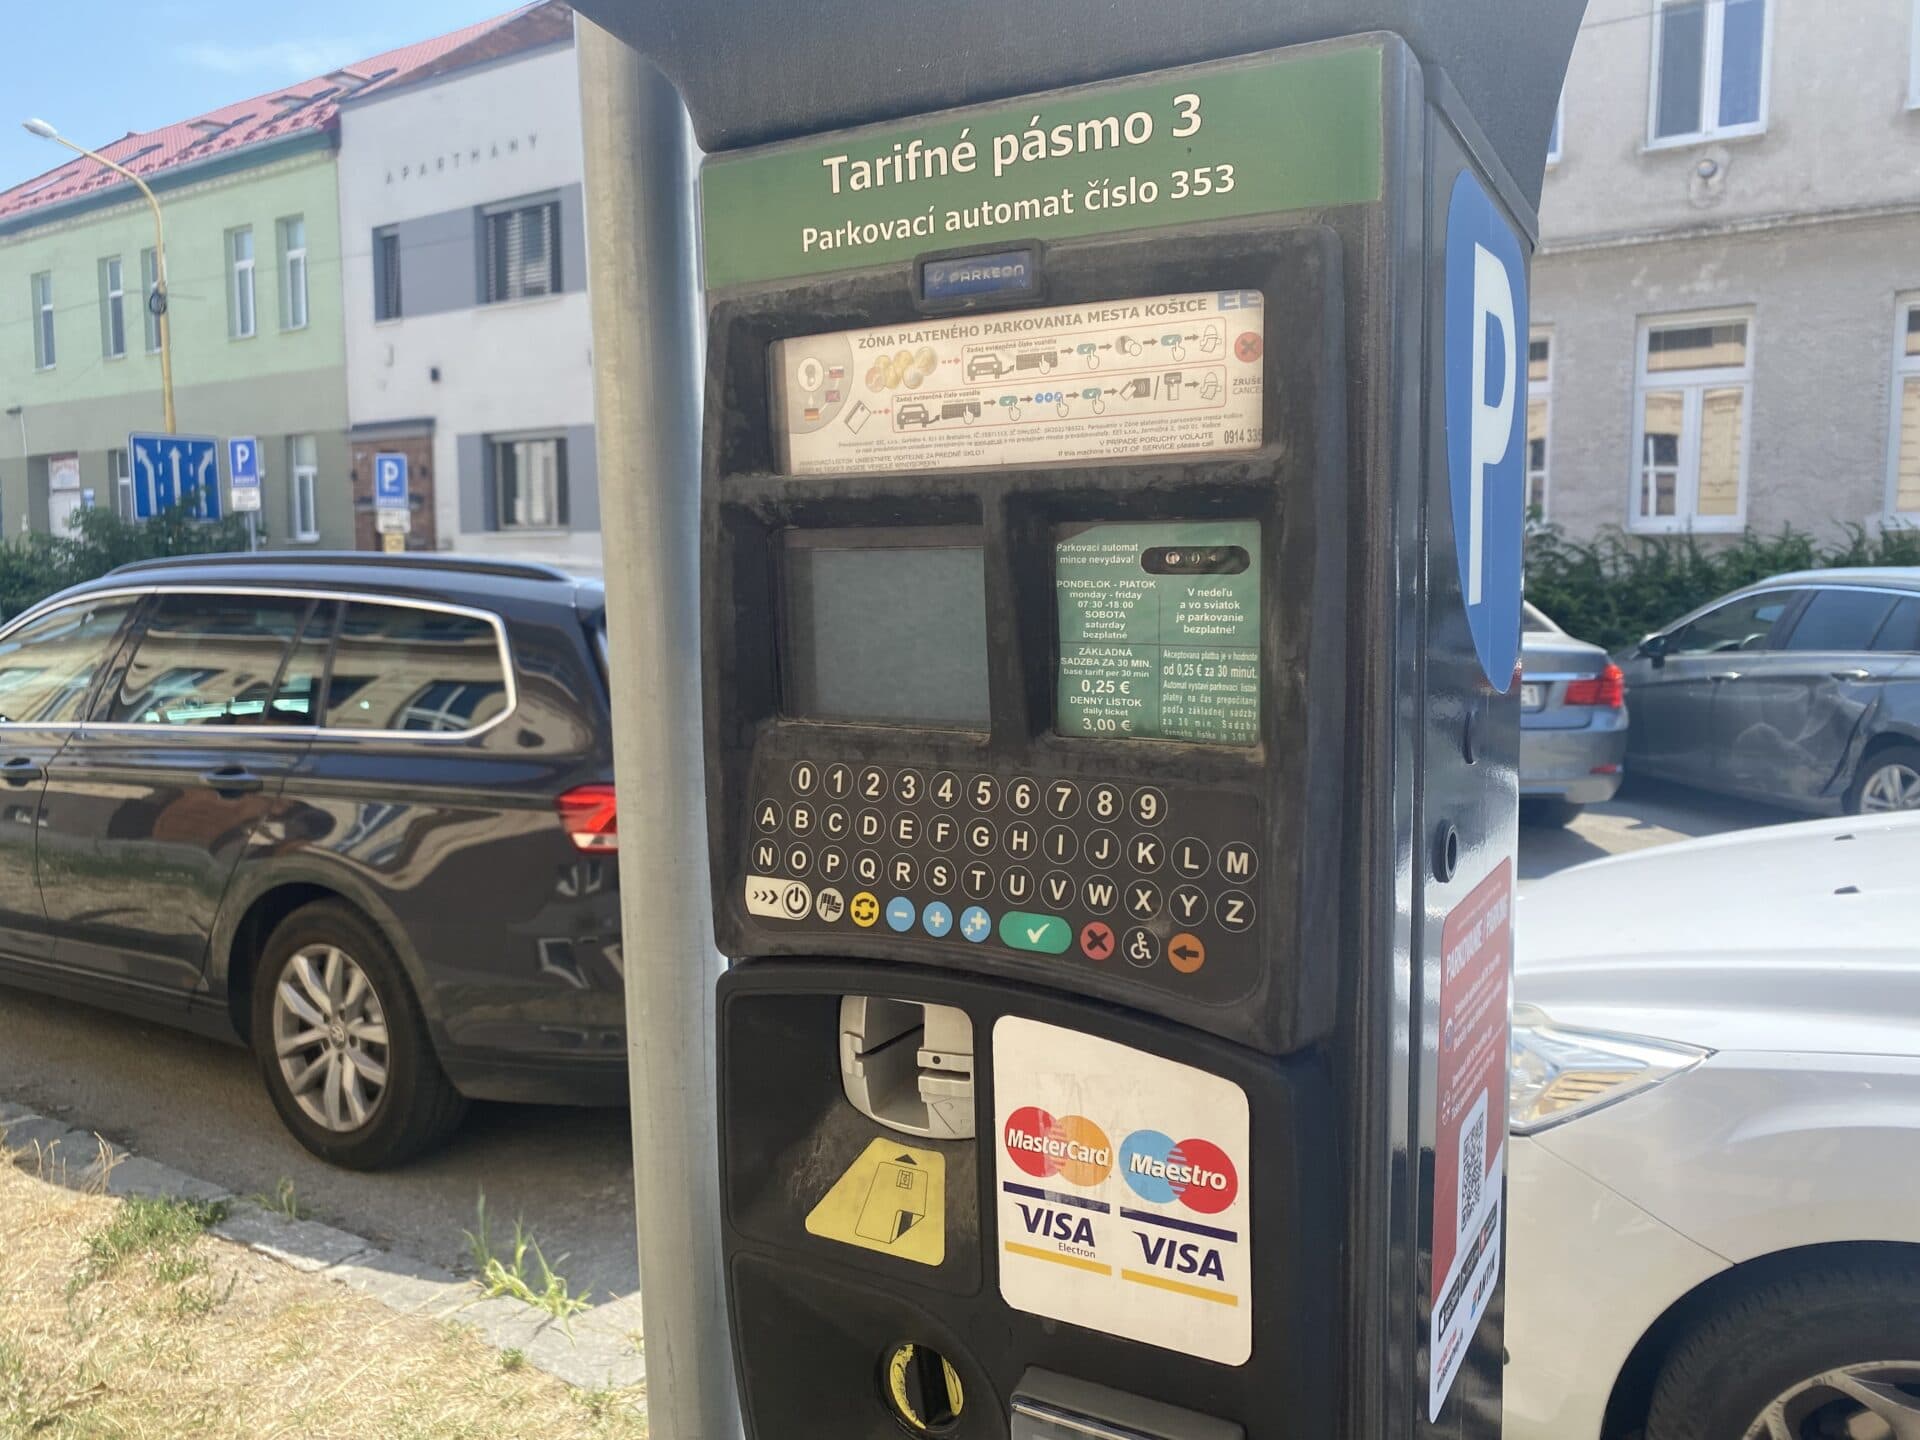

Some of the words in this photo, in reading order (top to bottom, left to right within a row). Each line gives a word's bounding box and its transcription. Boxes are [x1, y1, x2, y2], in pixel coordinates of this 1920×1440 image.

[823, 127, 977, 195] Tarifné
[993, 110, 1154, 176] pásmo
[1172, 93, 1202, 137] 3
[802, 205, 935, 253] Parkovací
[945, 187, 1074, 231] automat
[1084, 174, 1159, 211] číslo
[1170, 164, 1236, 200] 353
[858, 333, 895, 349] ZÓNA
[899, 321, 980, 345] PLATENÉHO
[984, 314, 1083, 334] PARKOVANIA
[1087, 306, 1141, 324] MESTA
[1145, 298, 1208, 317] KOŠICE
[1469, 242, 1517, 606] P
[1224, 428, 1245, 444] 0914
[237, 443, 250, 473] P
[384, 460, 399, 493] P
[1102, 543, 1138, 552] automat
[1060, 555, 1087, 564] mince
[1056, 580, 1111, 588] PONDELOK
[1119, 580, 1156, 588] PIATOK
[1069, 590, 1107, 600] monday
[1115, 590, 1142, 600] friday
[1187, 588, 1195, 597] V
[1203, 600, 1240, 609] sviatok
[1085, 610, 1126, 619] SOBOTA
[1176, 612, 1185, 623] je
[1188, 612, 1244, 623] parkovanie
[1085, 620, 1126, 631] saturday
[1060, 657, 1100, 666] SADZBA
[1102, 658, 1115, 667] ZA
[1117, 659, 1129, 667] 30
[1105, 670, 1120, 678] per
[1121, 669, 1132, 677] 30
[1163, 663, 1175, 676] od
[1196, 663, 1203, 677] €
[1205, 667, 1215, 677] za
[1217, 665, 1228, 678] 30
[1081, 679, 1115, 695] 0,25
[1120, 681, 1131, 694] €
[1070, 695, 1104, 705] DENNÝ
[1083, 707, 1103, 717] daily
[1105, 707, 1129, 716] ticket
[1082, 717, 1116, 732] 3,00
[1121, 720, 1132, 732] €
[798, 767, 811, 790] 0
[833, 769, 843, 793] 1
[865, 772, 880, 796] 2
[901, 775, 916, 799] 3
[937, 778, 953, 803] 4
[976, 780, 991, 806] 5
[1015, 784, 1030, 809] 6
[1056, 787, 1072, 812] 7
[1097, 790, 1113, 816] 8
[1140, 793, 1157, 820] 9
[761, 806, 776, 826] A
[794, 809, 809, 829] B
[828, 812, 843, 833] C
[863, 815, 878, 836] D
[899, 819, 914, 840] E
[936, 822, 950, 843] F
[972, 826, 990, 847] G
[1012, 829, 1028, 852] H
[1057, 834, 1064, 856] I
[1095, 838, 1109, 860] J
[1137, 841, 1156, 865] K
[1183, 846, 1199, 870] L
[1226, 850, 1249, 875] M
[759, 846, 773, 866] N
[791, 850, 807, 870] O
[826, 853, 840, 873] P
[859, 857, 876, 880] Q
[896, 861, 911, 883] R
[932, 865, 947, 887] S
[971, 869, 986, 891] T
[1009, 874, 1026, 896] U
[1050, 878, 1067, 901] V
[1088, 883, 1113, 907] W
[1134, 888, 1152, 912] X
[1179, 893, 1198, 917] Y
[1225, 899, 1244, 924] Z
[1007, 1128, 1110, 1168] MasterCard
[1129, 1152, 1228, 1190] Maestro
[1015, 1202, 1096, 1248] VISA
[1058, 1242, 1096, 1259] Electron
[1132, 1230, 1225, 1282] VISA
